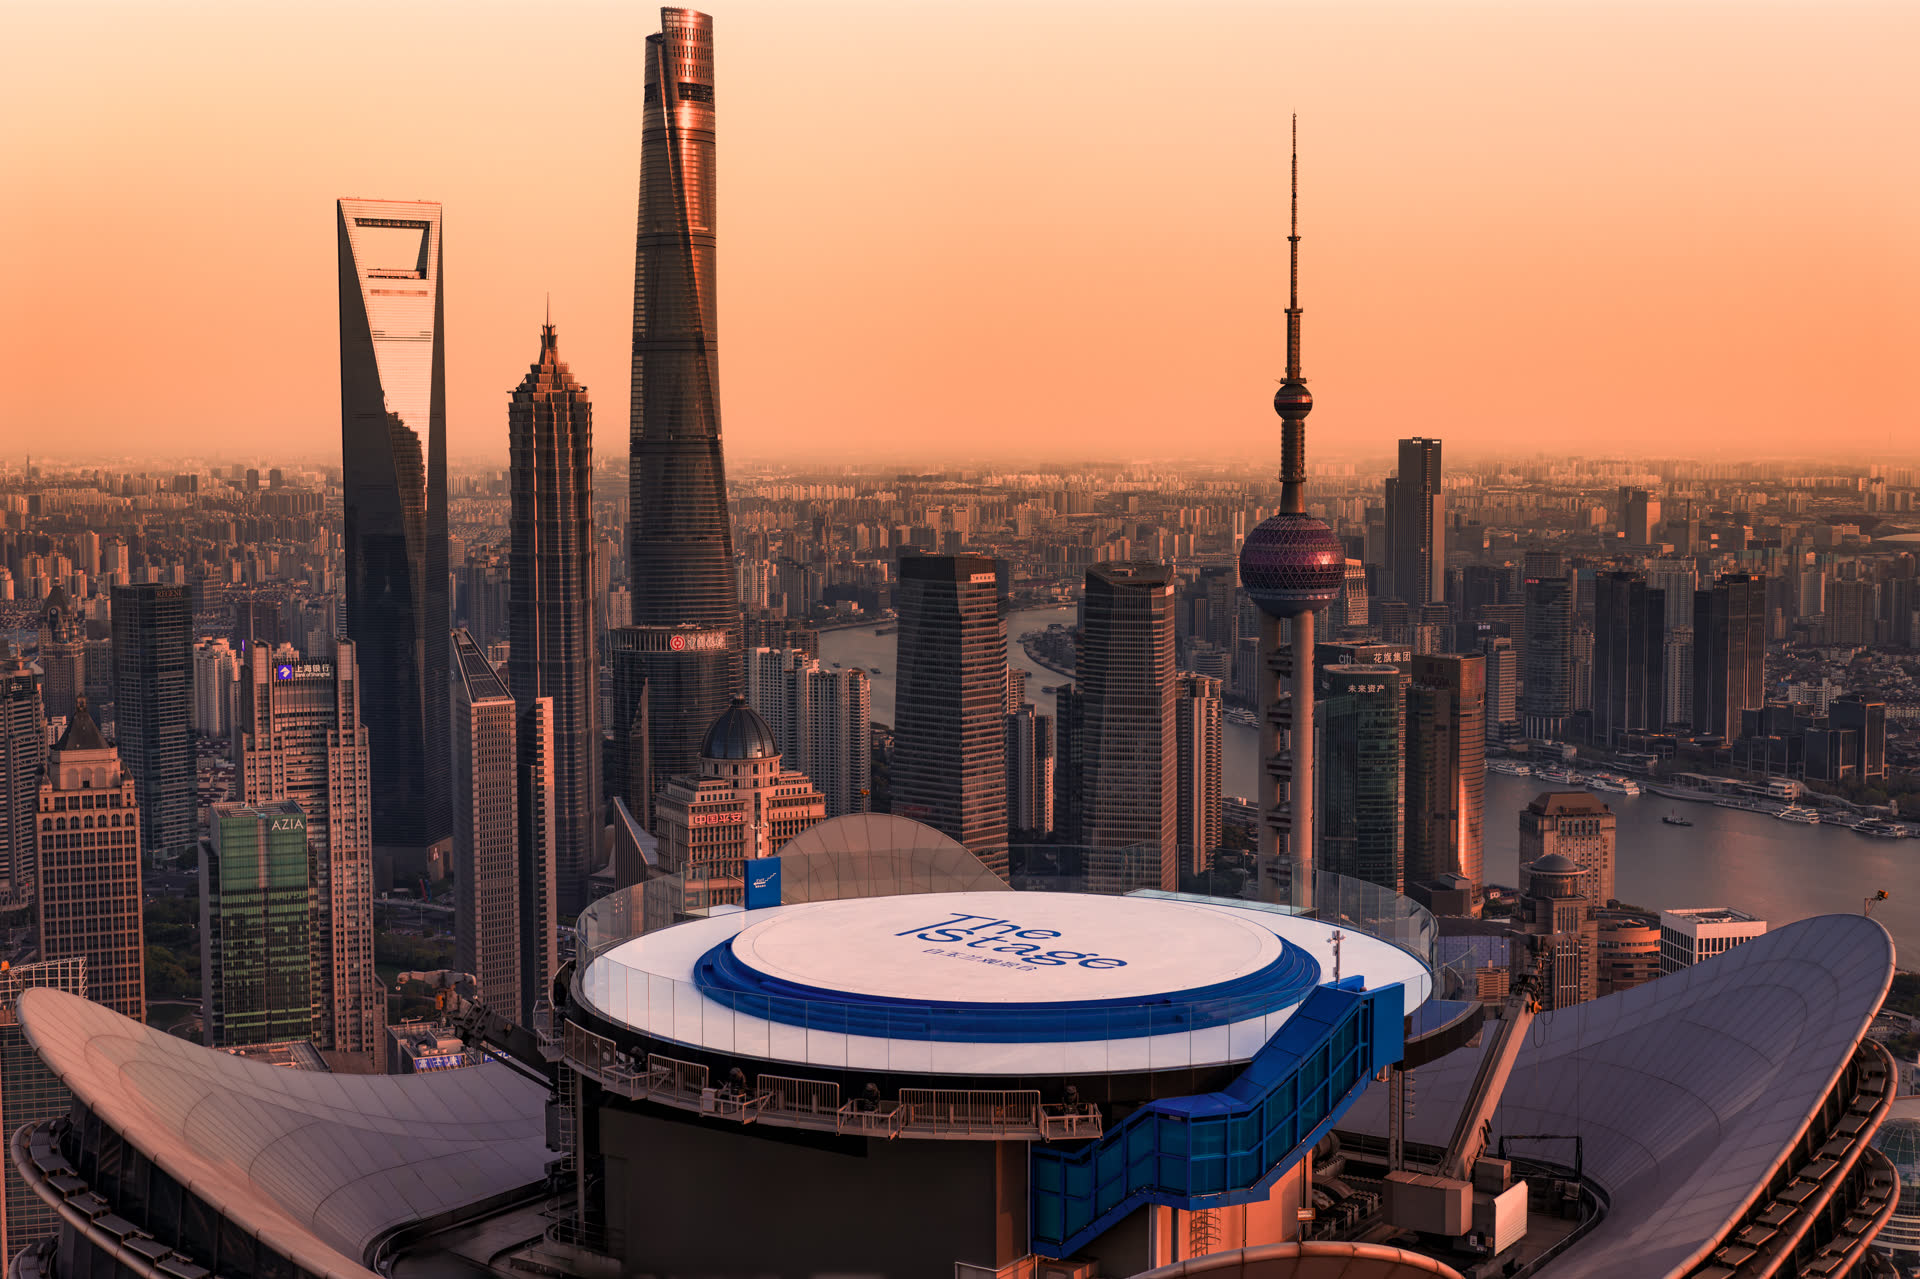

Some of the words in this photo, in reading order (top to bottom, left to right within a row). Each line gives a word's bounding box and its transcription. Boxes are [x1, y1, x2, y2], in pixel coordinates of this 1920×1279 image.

[1373, 651, 1411, 663] 花旗集团
[295, 664, 330, 673] 上海银行
[1347, 684, 1385, 693] 未来资产
[271, 818, 305, 831] AZIA
[695, 812, 742, 825] 中国平安
[894, 913, 1061, 939] The
[916, 928, 1128, 969] Stage
